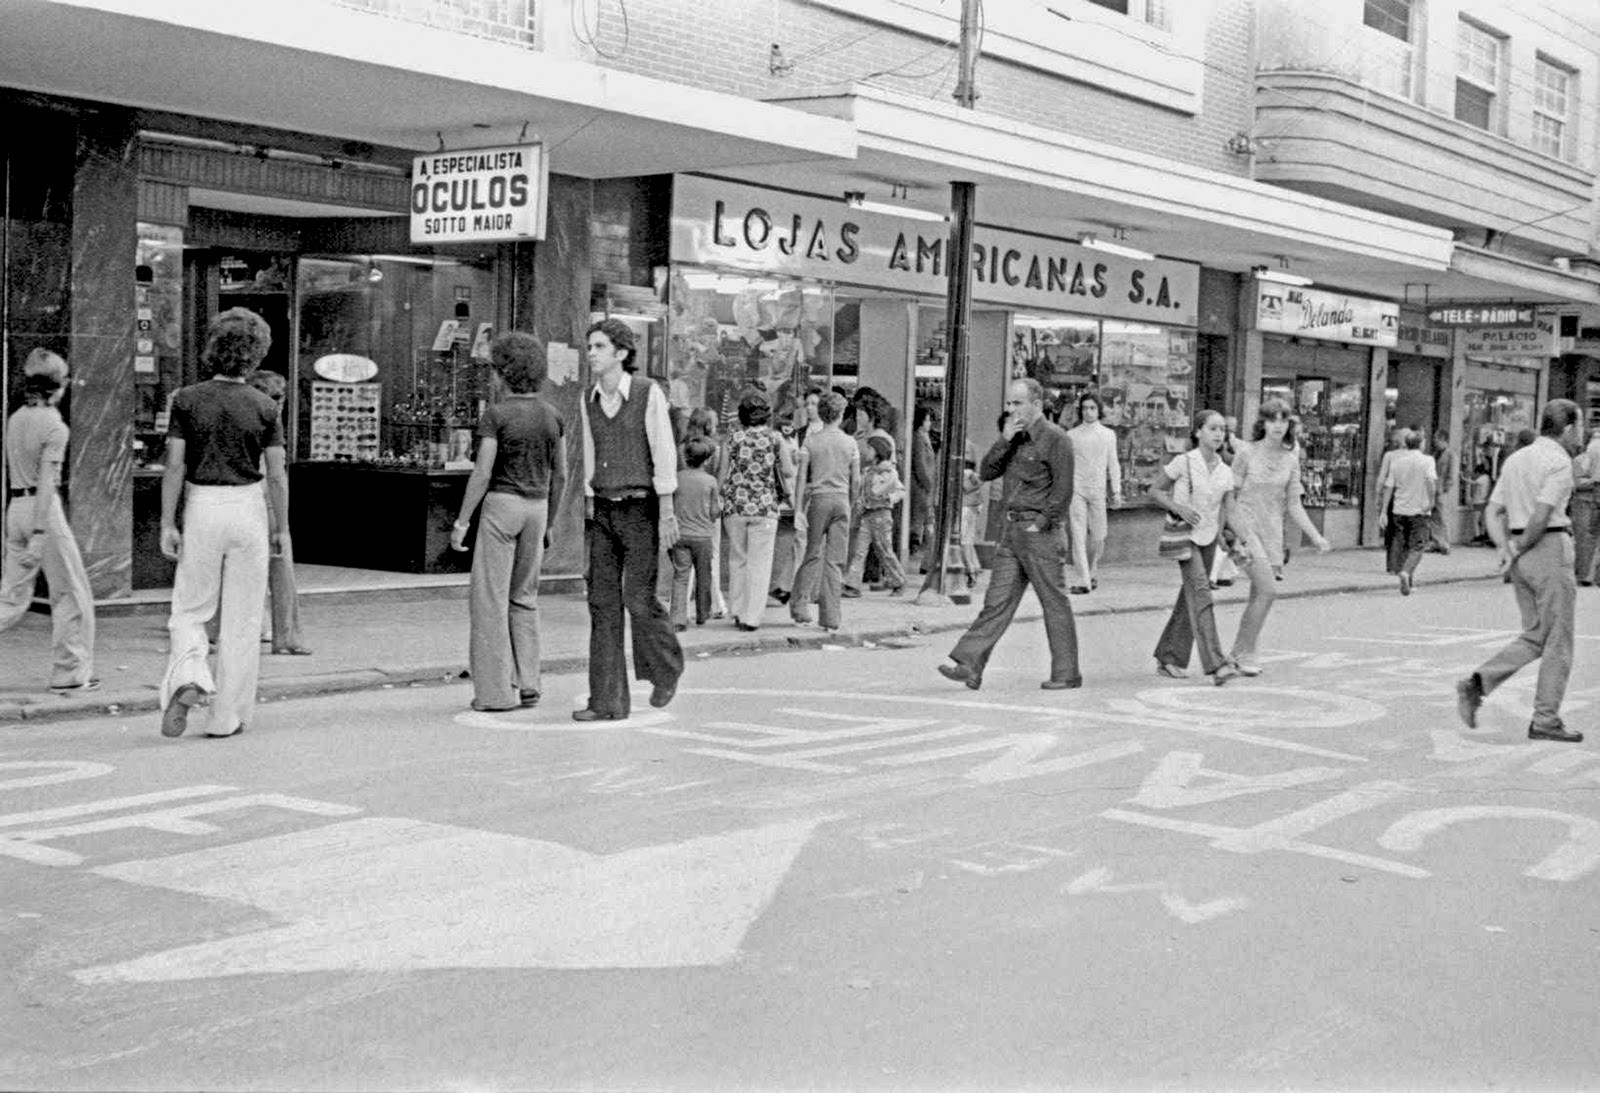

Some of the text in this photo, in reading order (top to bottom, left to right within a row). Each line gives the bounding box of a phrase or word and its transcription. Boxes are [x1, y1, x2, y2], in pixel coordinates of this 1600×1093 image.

[420, 152, 522, 176] A ESPECIALISTA
[425, 213, 513, 234] SOTTO MAIOR
[714, 200, 1180, 309] LOJAS AMRICANAS S.A.
